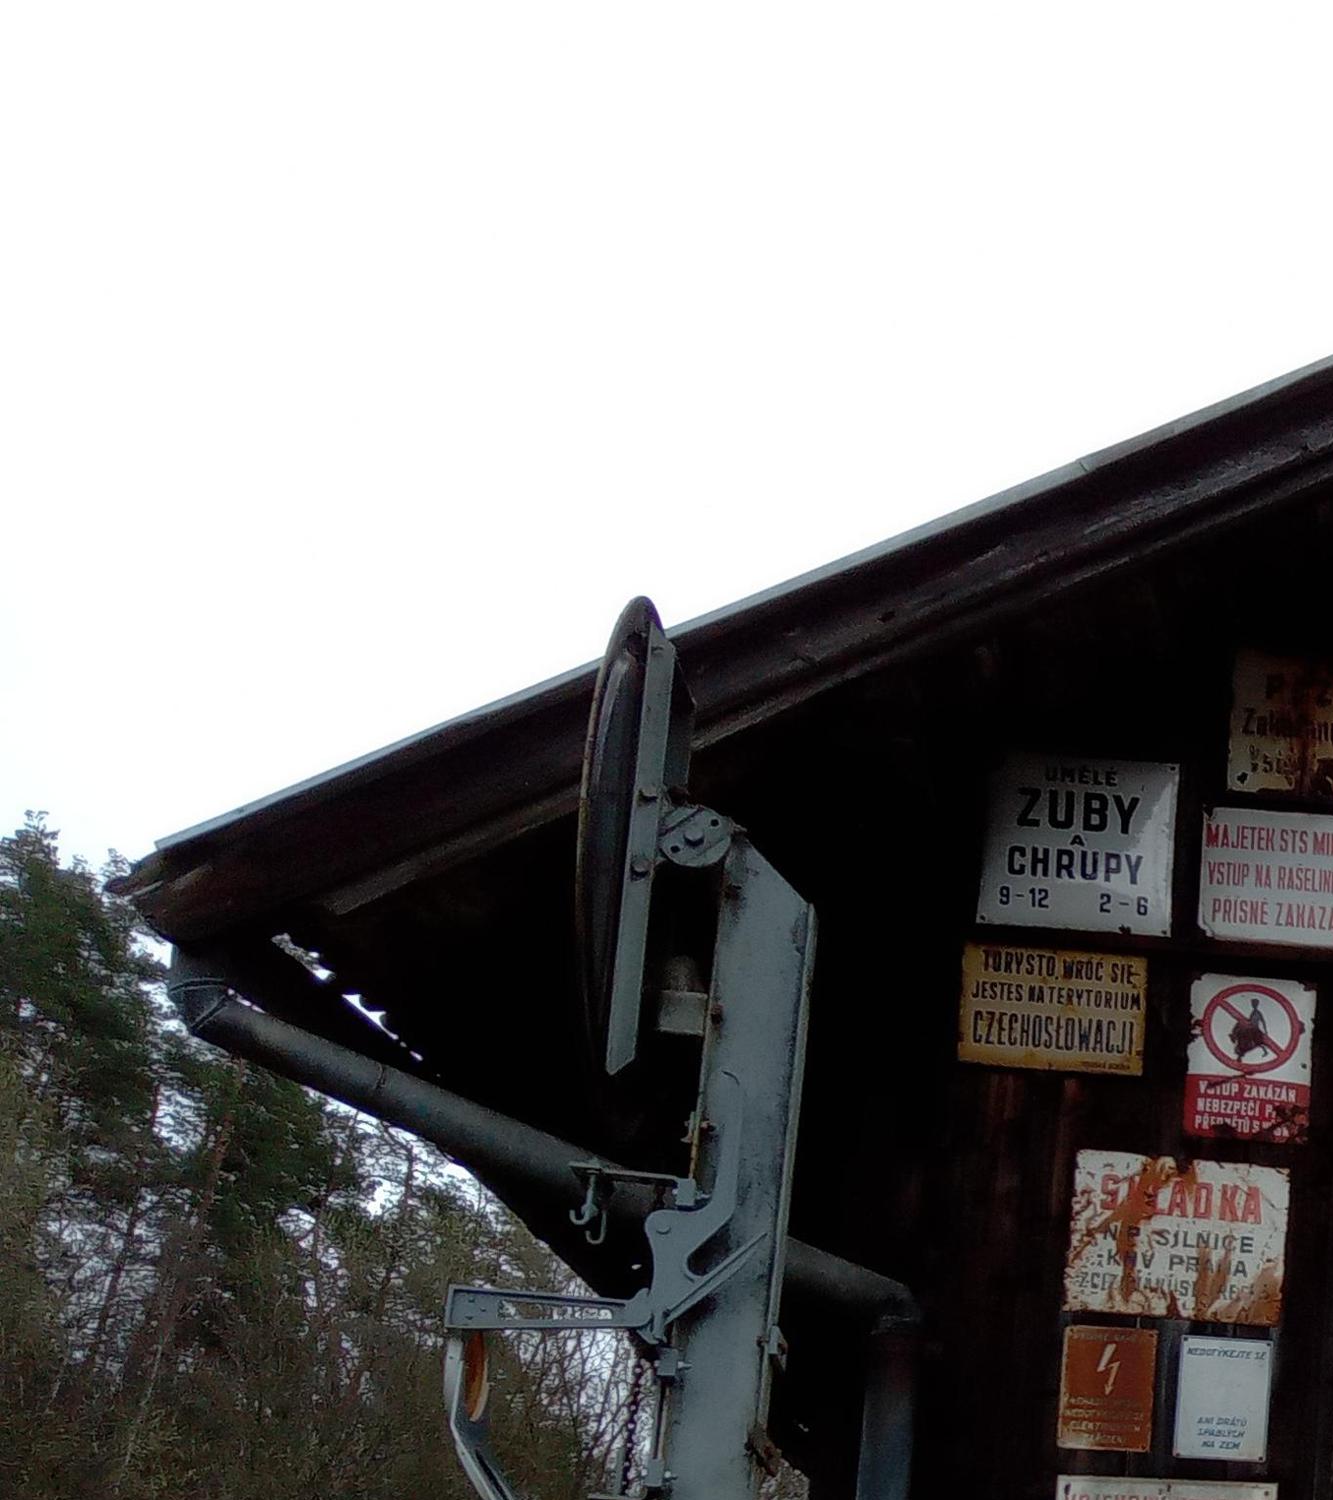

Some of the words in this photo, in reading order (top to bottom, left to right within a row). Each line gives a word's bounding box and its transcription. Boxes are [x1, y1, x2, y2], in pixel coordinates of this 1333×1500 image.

[1017, 789, 1140, 834] ZUBY
[1070, 833, 1085, 847] A
[1008, 847, 1143, 886] CHRUPY
[1207, 866, 1250, 887] VSTUP
[1255, 868, 1273, 889] NA
[1212, 901, 1269, 926] PŘÍSNĚ
[973, 1010, 1135, 1055] CZECHOSŁOWACJI
[1196, 1098, 1261, 1115] NEBEZPEČÍ
